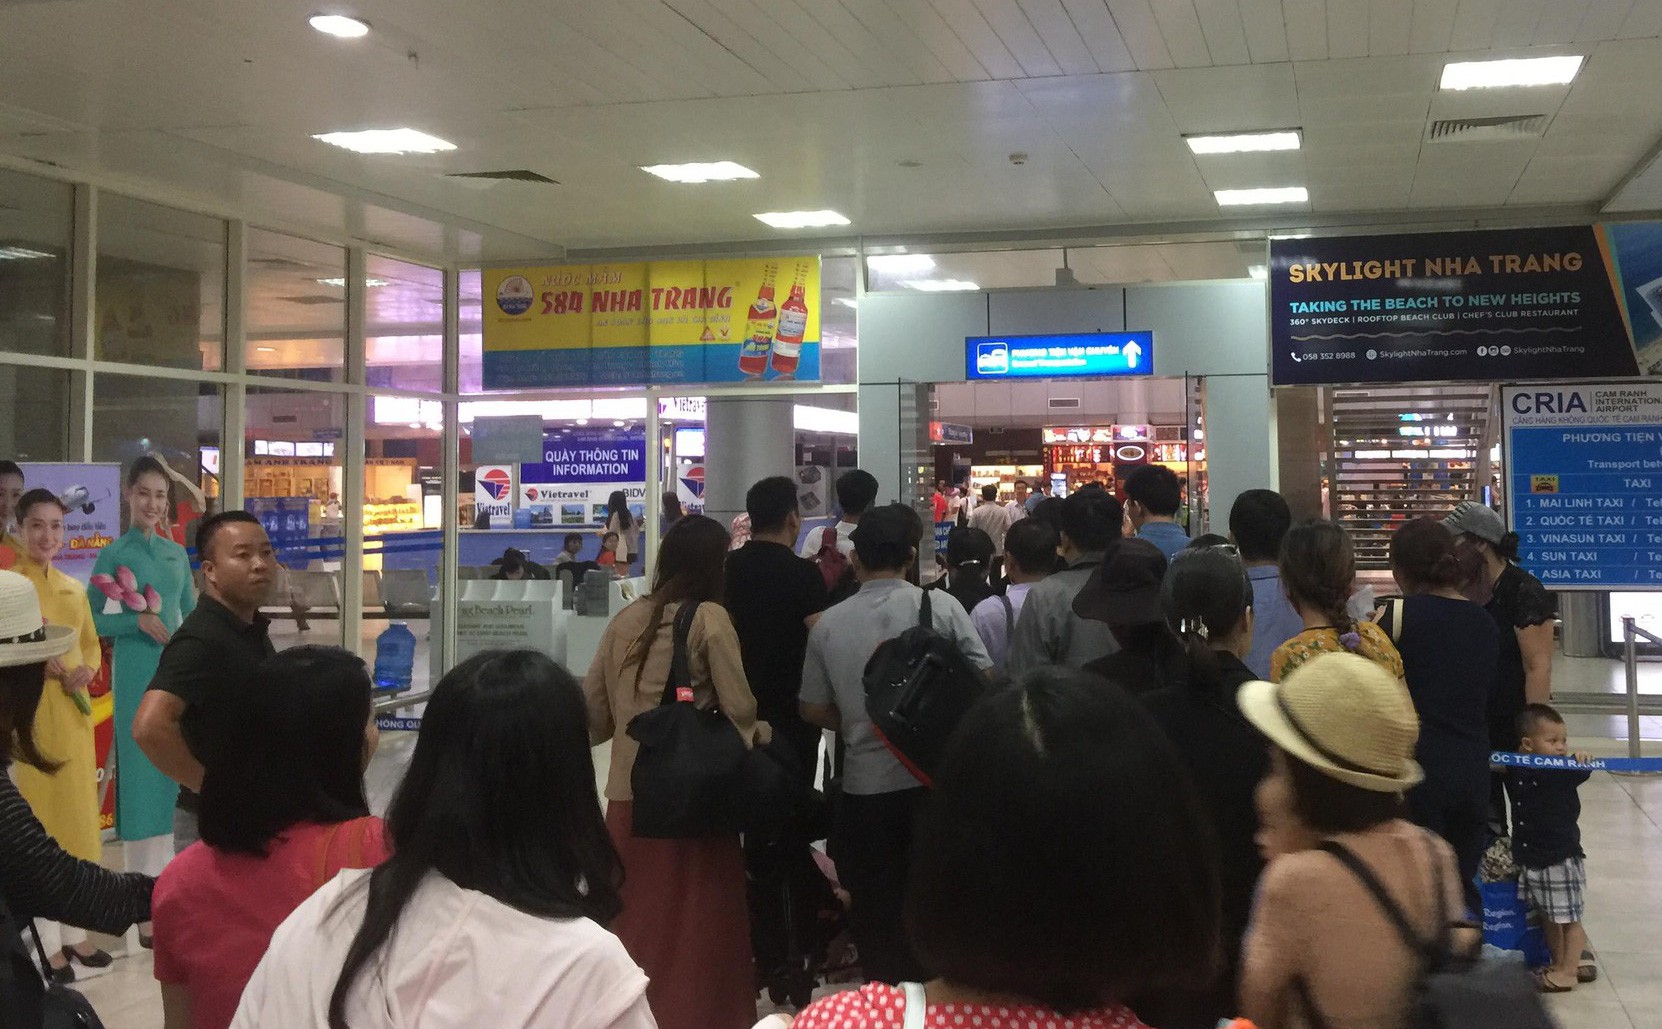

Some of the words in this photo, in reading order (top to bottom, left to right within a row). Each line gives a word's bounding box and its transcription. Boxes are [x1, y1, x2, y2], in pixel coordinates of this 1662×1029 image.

[1289, 258, 1416, 283] SKYLIGHT
[1425, 256, 1482, 277] NHA
[1489, 252, 1583, 274] TRANG
[592, 289, 642, 313] NHA
[651, 286, 732, 311] TRANG
[1290, 300, 1347, 314] TAKING
[1351, 299, 1381, 311] THE
[1385, 297, 1438, 310] BEACH
[1442, 296, 1463, 308] TO
[1468, 294, 1506, 307] NEW
[1511, 292, 1581, 305] HEIGHTS
[1311, 316, 1350, 325] SKYDECK
[1358, 315, 1398, 323] ROOFTOP
[1401, 313, 1430, 321] BEACH
[1432, 312, 1455, 320] CLUB
[1495, 310, 1518, 318] CLUB
[1521, 308, 1579, 317] RESTAURANT
[1320, 352, 1334, 360] 352
[1336, 351, 1356, 360] 8988
[1512, 391, 1587, 414] CRIA
[1596, 390, 1616, 398] CAM
[1563, 433, 1621, 443] PHƯƠNG
[579, 447, 618, 462] THÔNG
[621, 449, 639, 461] TIN
[553, 463, 629, 476] INFORMATION
[1587, 459, 1640, 470] Transport
[1624, 479, 1651, 488] TAXI
[541, 490, 589, 499] Vietravel
[1526, 499, 1535, 508] 1.
[1540, 499, 1562, 508] MAI
[1565, 499, 1592, 508] LINH
[1596, 499, 1623, 507] TAXI
[1526, 516, 1535, 525] 2.
[1597, 516, 1624, 525] TAXI
[1526, 534, 1536, 543] 3.
[1540, 534, 1594, 543] VINASUN
[1598, 534, 1625, 543] TAXI
[1541, 552, 1566, 561] SUN
[1570, 552, 1597, 560] TAXI
[1542, 569, 1571, 579] ASIA
[1574, 570, 1601, 579] TAXI
[1534, 757, 1564, 767] CAM
